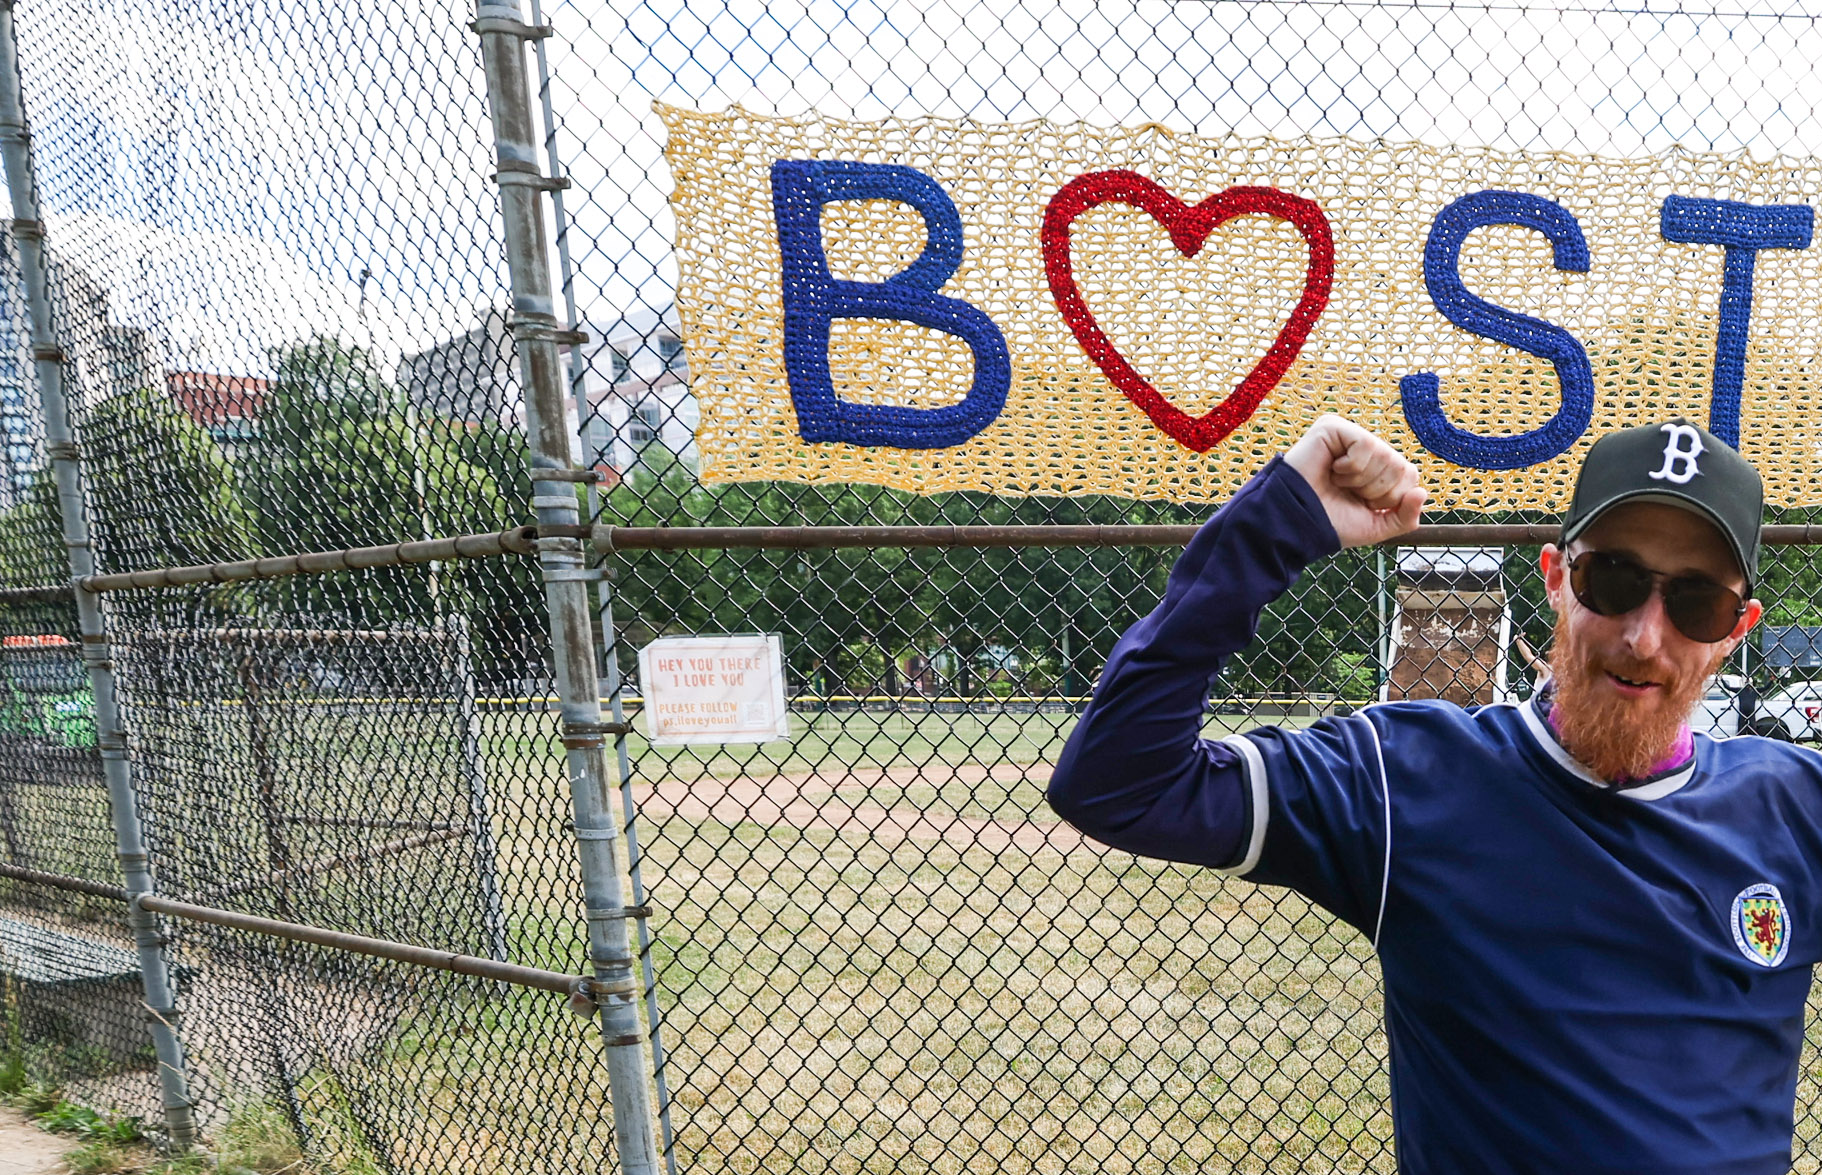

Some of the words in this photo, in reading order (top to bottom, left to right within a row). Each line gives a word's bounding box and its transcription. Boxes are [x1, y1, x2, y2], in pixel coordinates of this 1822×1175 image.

[1649, 423, 1709, 484] B
[658, 659, 683, 672] HEY
[689, 659, 713, 671] YOU
[720, 657, 761, 671] THERE
[673, 674, 679, 687] I
[684, 674, 716, 687] LOVE
[721, 673, 745, 686] YOU
[659, 703, 695, 714] PLEASE
[701, 702, 737, 713] FOLLOW
